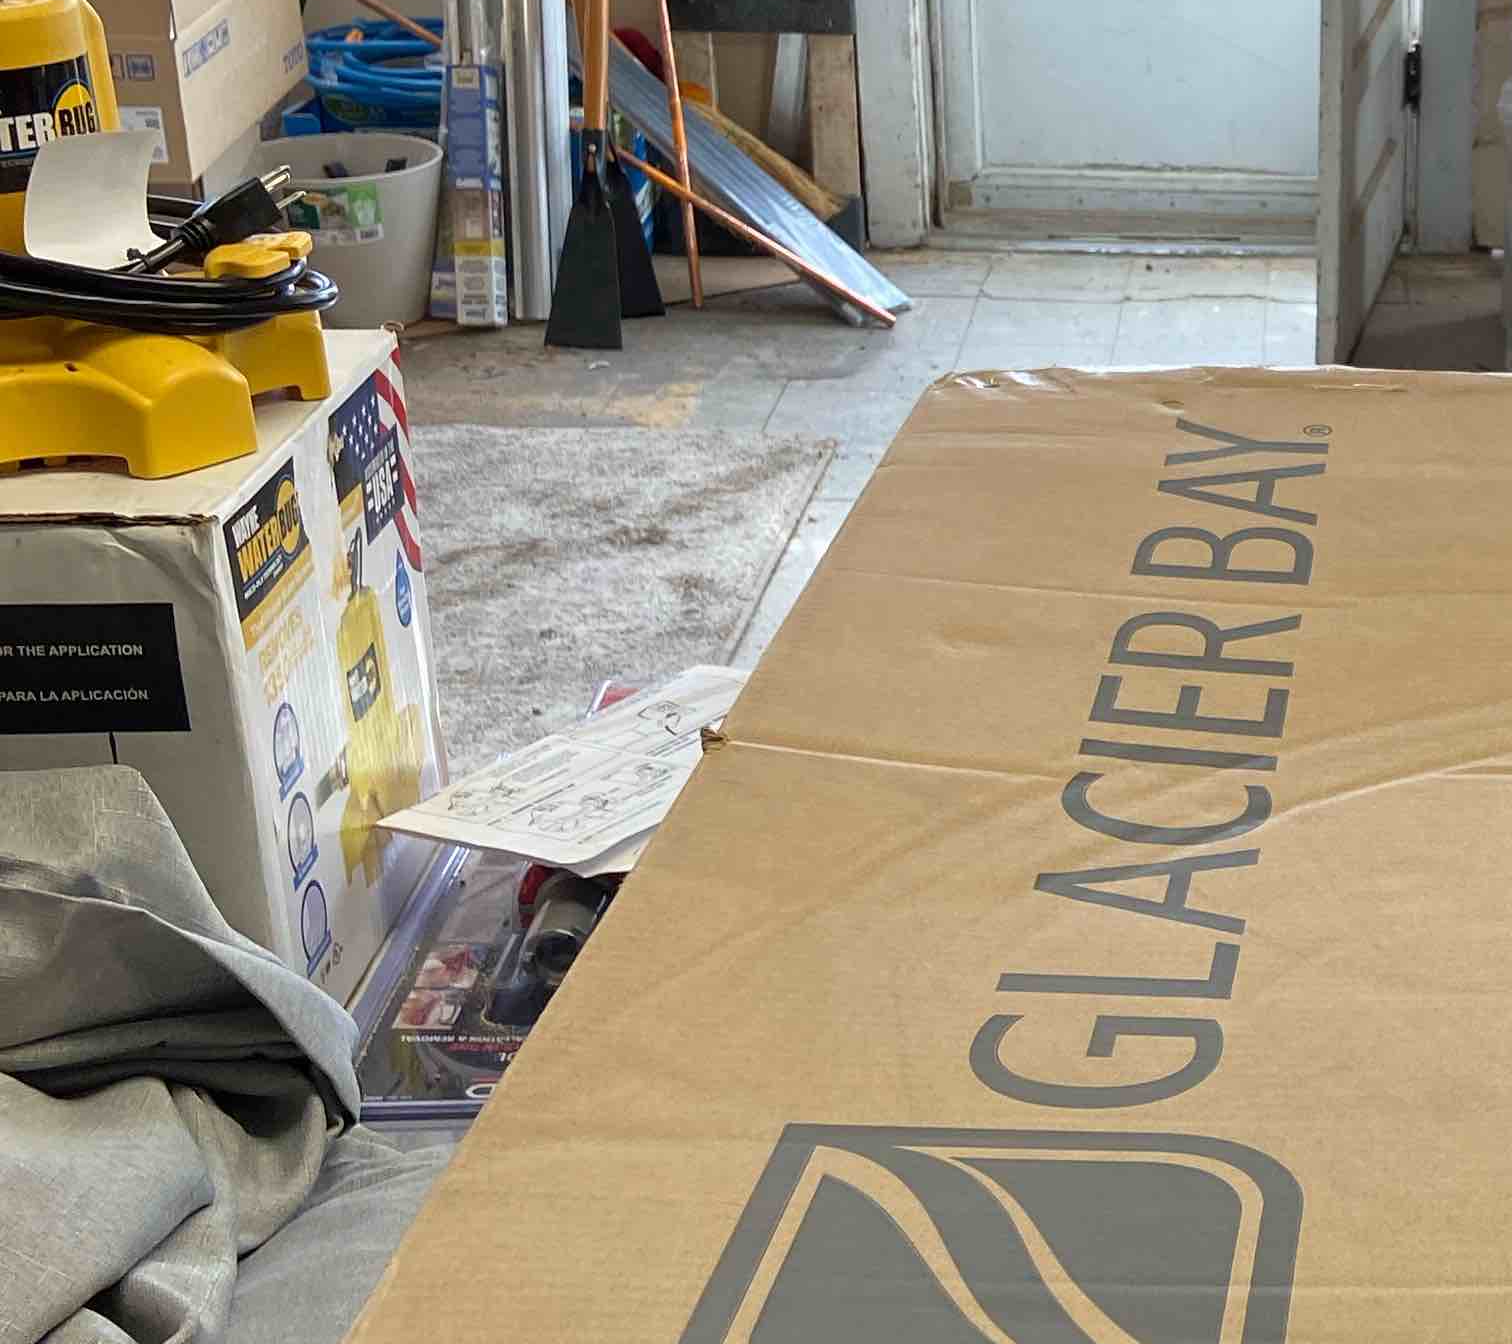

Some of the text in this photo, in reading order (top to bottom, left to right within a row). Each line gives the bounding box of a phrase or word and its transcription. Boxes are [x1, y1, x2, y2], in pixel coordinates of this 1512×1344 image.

[16, 644, 46, 656] THE
[49, 644, 143, 657] APPLICATION
[0, 691, 37, 702] PARA
[40, 690, 59, 702] LA
[968, 417, 1331, 1110] GLACIER BAY
